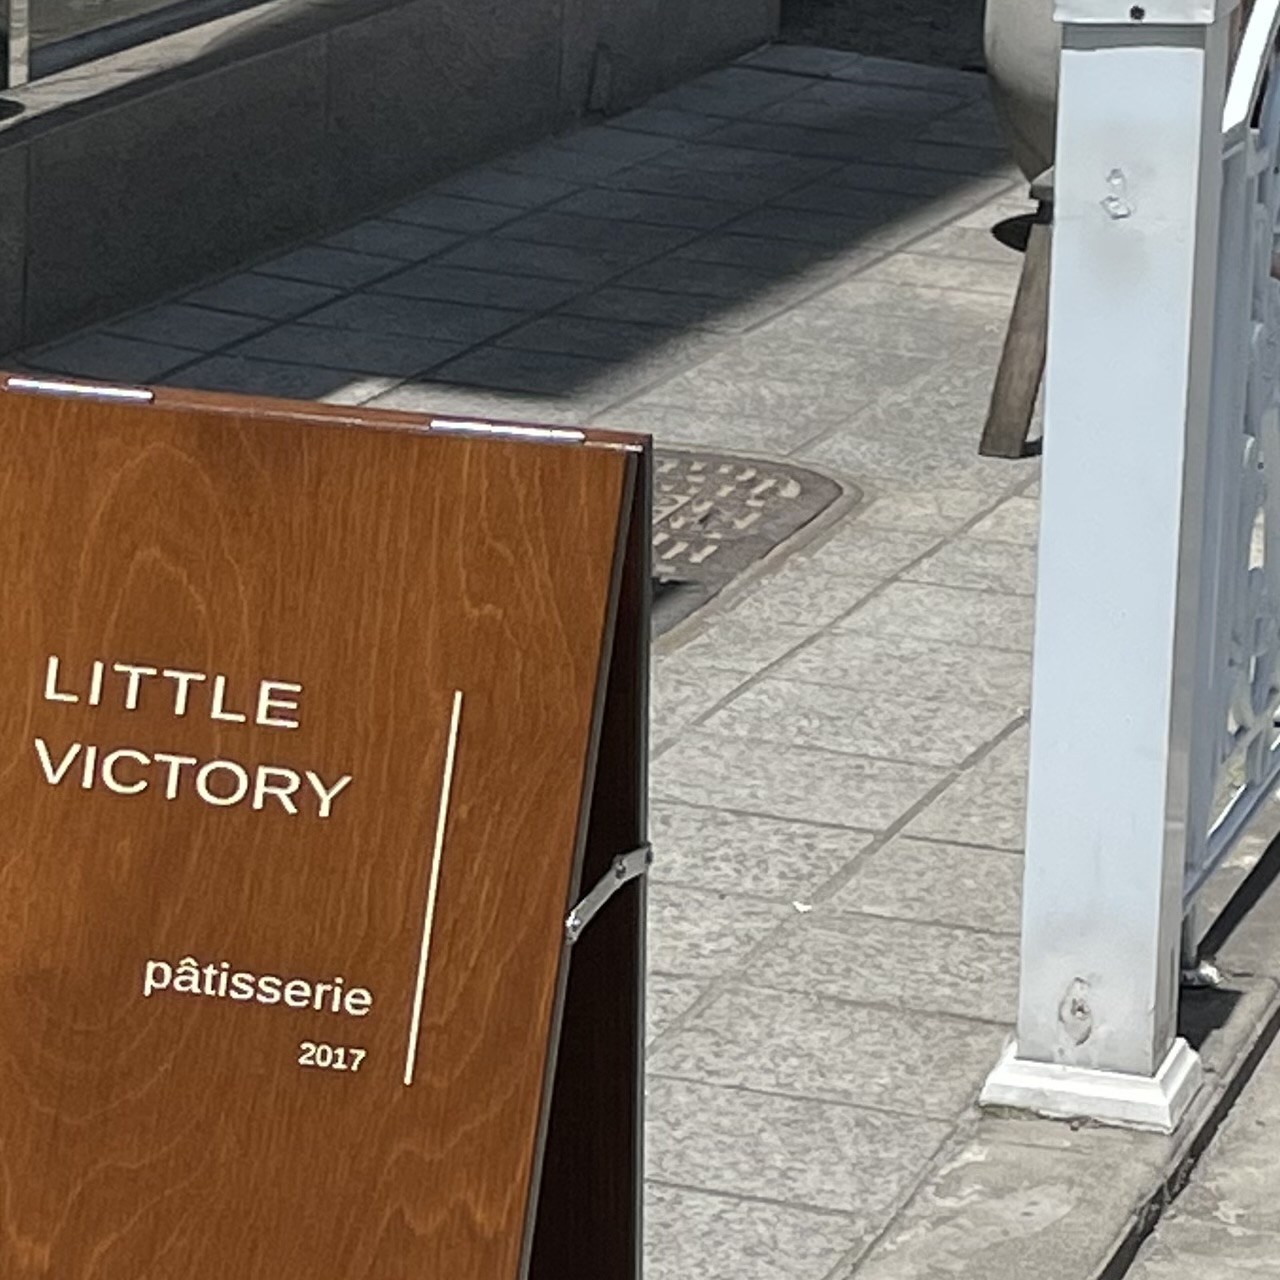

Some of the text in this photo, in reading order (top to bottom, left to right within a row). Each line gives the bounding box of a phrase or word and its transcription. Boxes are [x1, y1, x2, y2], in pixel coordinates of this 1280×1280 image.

[43, 655, 303, 729] LITTLE
[34, 738, 353, 818] VICTORY
[143, 955, 374, 1017] pâtisserie
[297, 1041, 367, 1072] 2017
